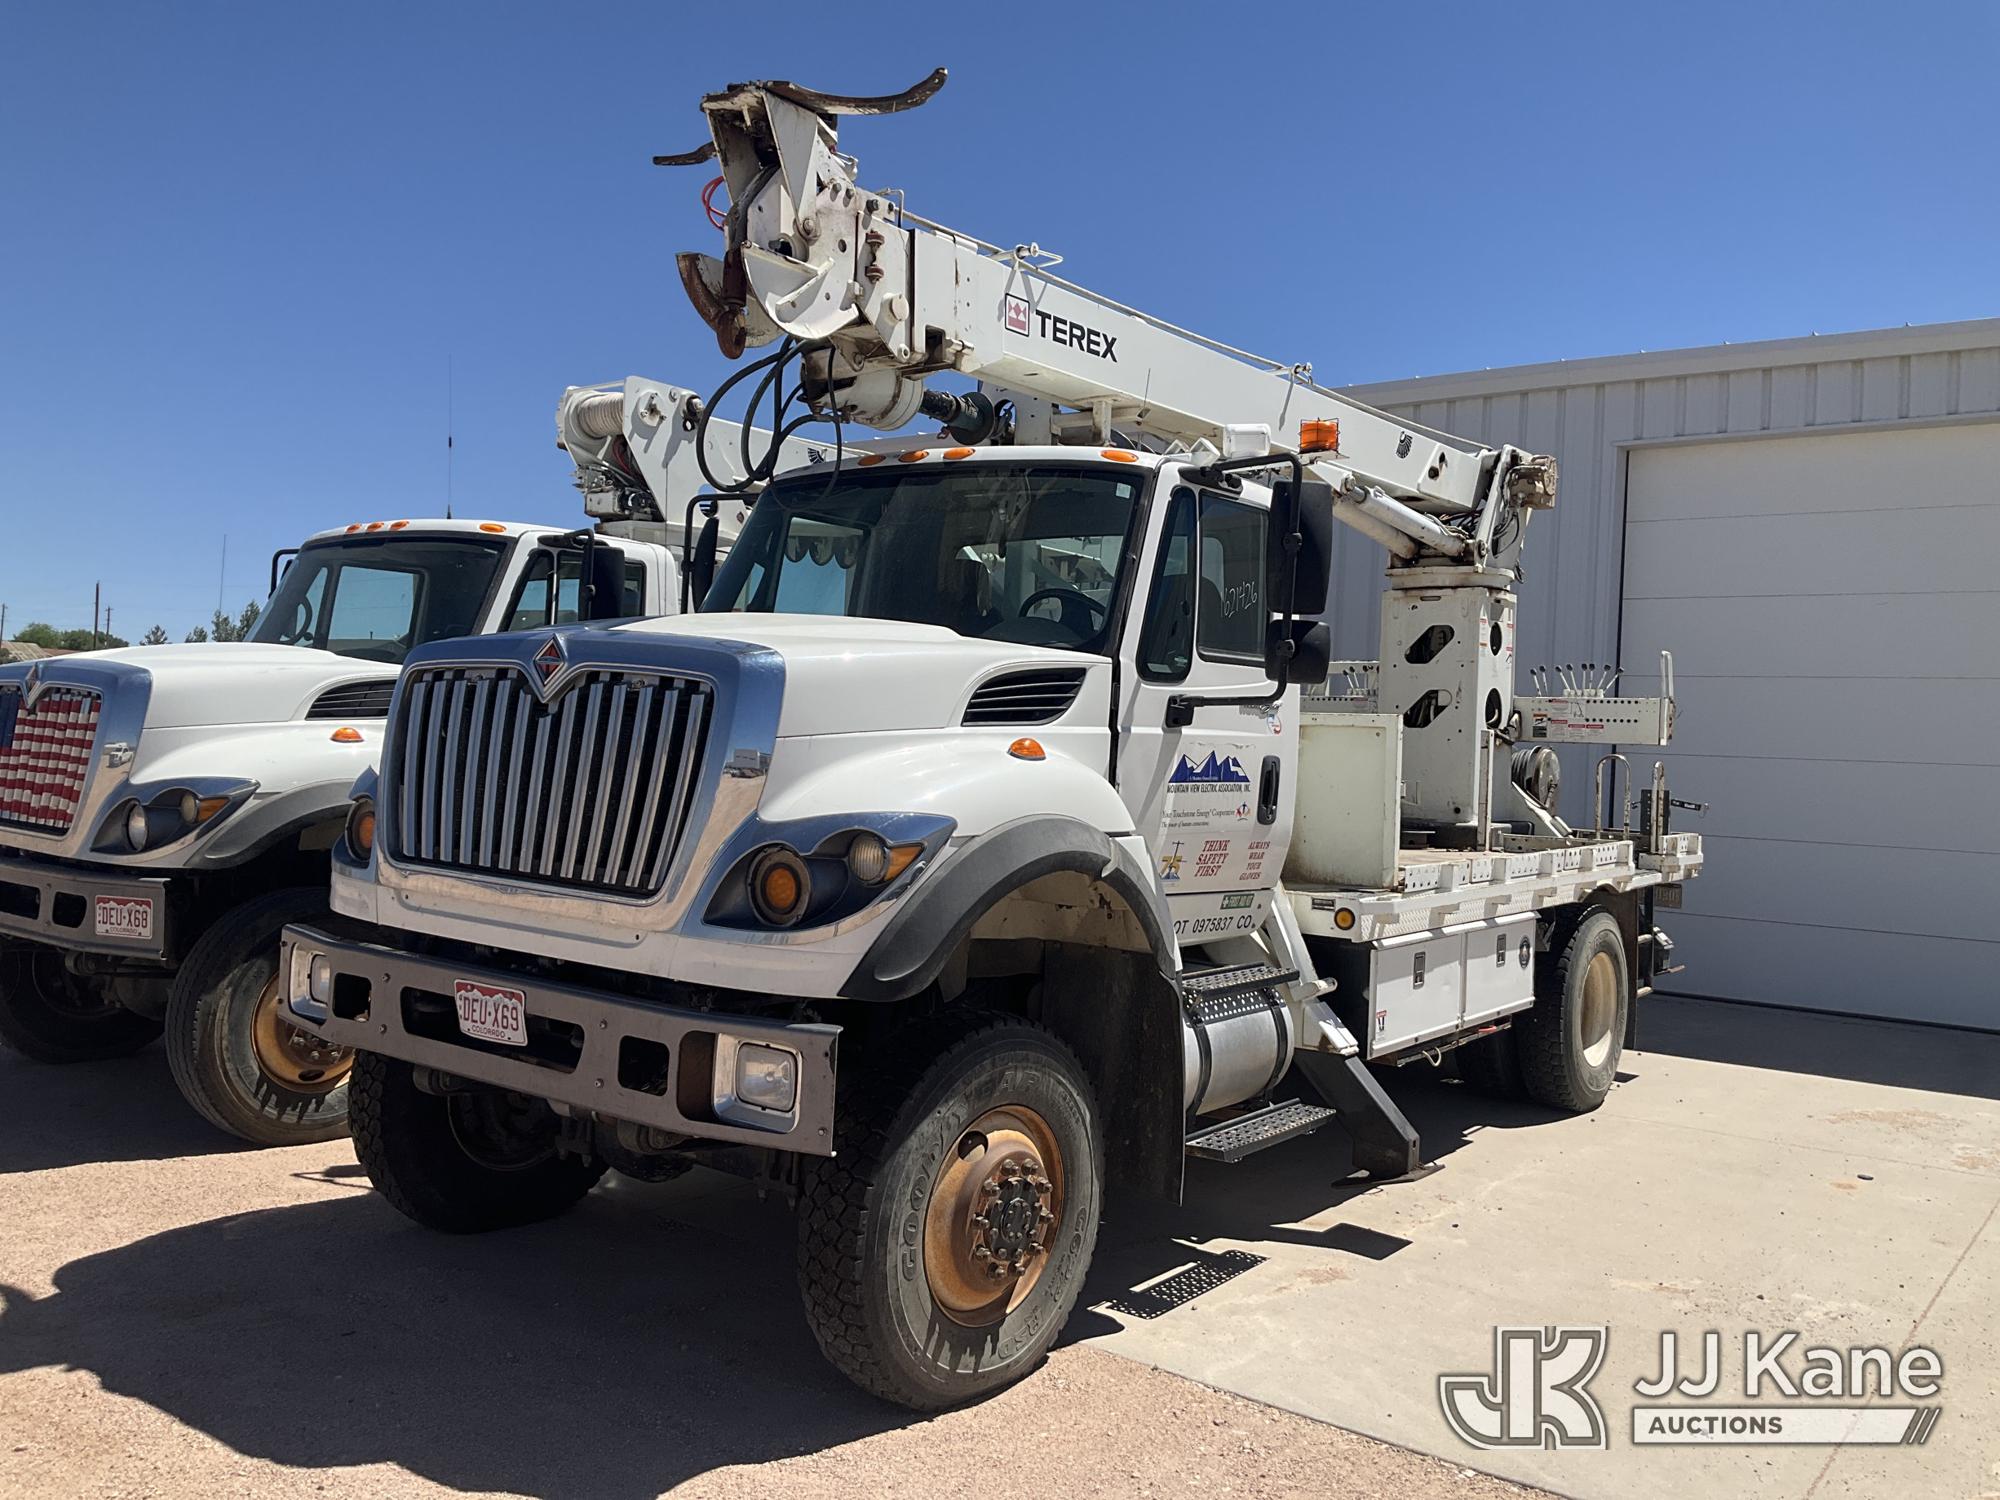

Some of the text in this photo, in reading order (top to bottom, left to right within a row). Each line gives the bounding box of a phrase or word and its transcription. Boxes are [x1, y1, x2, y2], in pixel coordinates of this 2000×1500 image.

[1035, 309, 1118, 363] TEREX
[1190, 784, 1201, 793] VIEW
[1201, 784, 1218, 793] ELECTRIC
[1202, 840, 1231, 853] THINK
[1248, 841, 1271, 850] ALWAYS
[1196, 853, 1229, 866] SAFETY
[1249, 851, 1266, 860] WEAR
[1194, 865, 1222, 878] FIRST
[1246, 862, 1262, 871] YOUR
[1239, 872, 1262, 881] GLOVES
[1192, 917, 1233, 933] 0975837
[471, 1024, 506, 1038] COLORADO
